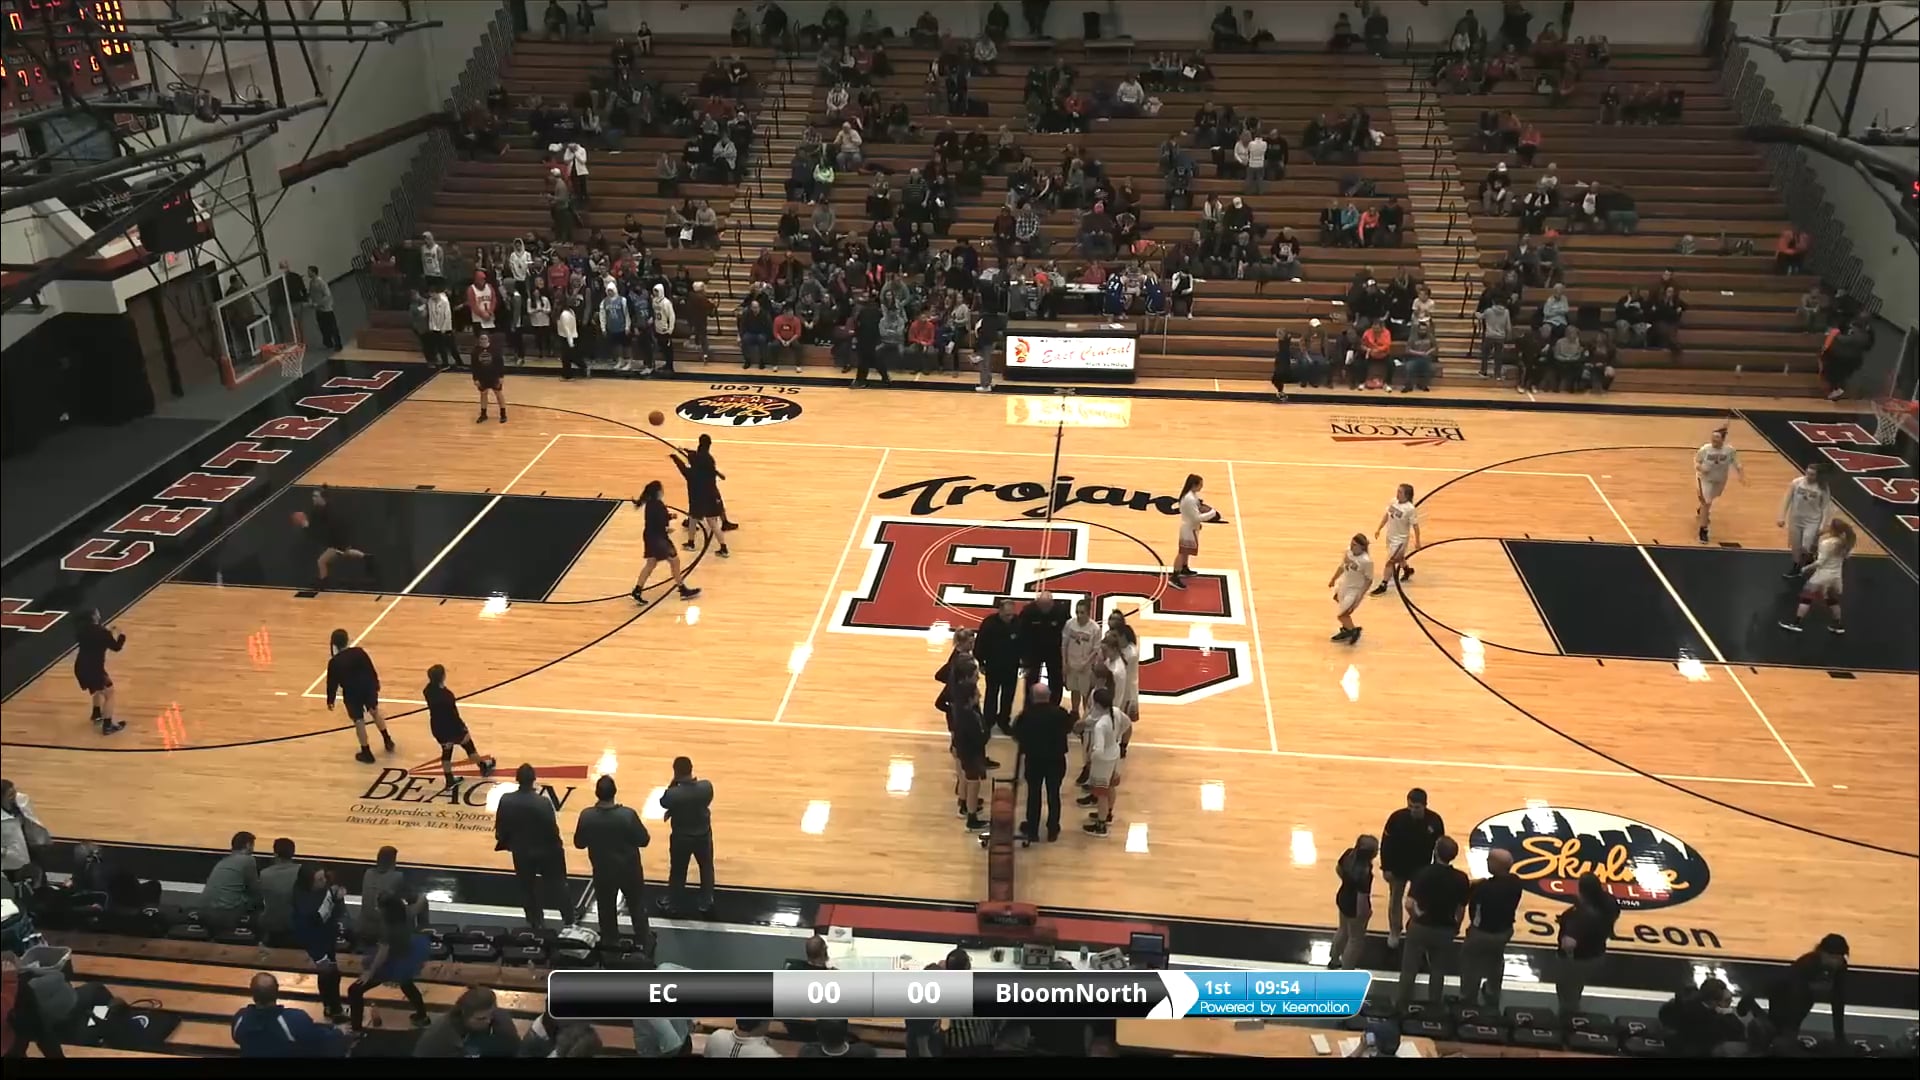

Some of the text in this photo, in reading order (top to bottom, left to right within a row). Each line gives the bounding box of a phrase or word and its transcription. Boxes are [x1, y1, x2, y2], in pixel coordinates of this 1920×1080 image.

[710, 383, 802, 395] St. Leon
[1331, 423, 1466, 441] BEACON
[60, 370, 404, 573] CENTRAL
[877, 475, 1230, 525] Trojan
[359, 767, 577, 812] BEACN
[345, 815, 377, 825] David
[350, 803, 495, 822] Orthopaedics & Sports
